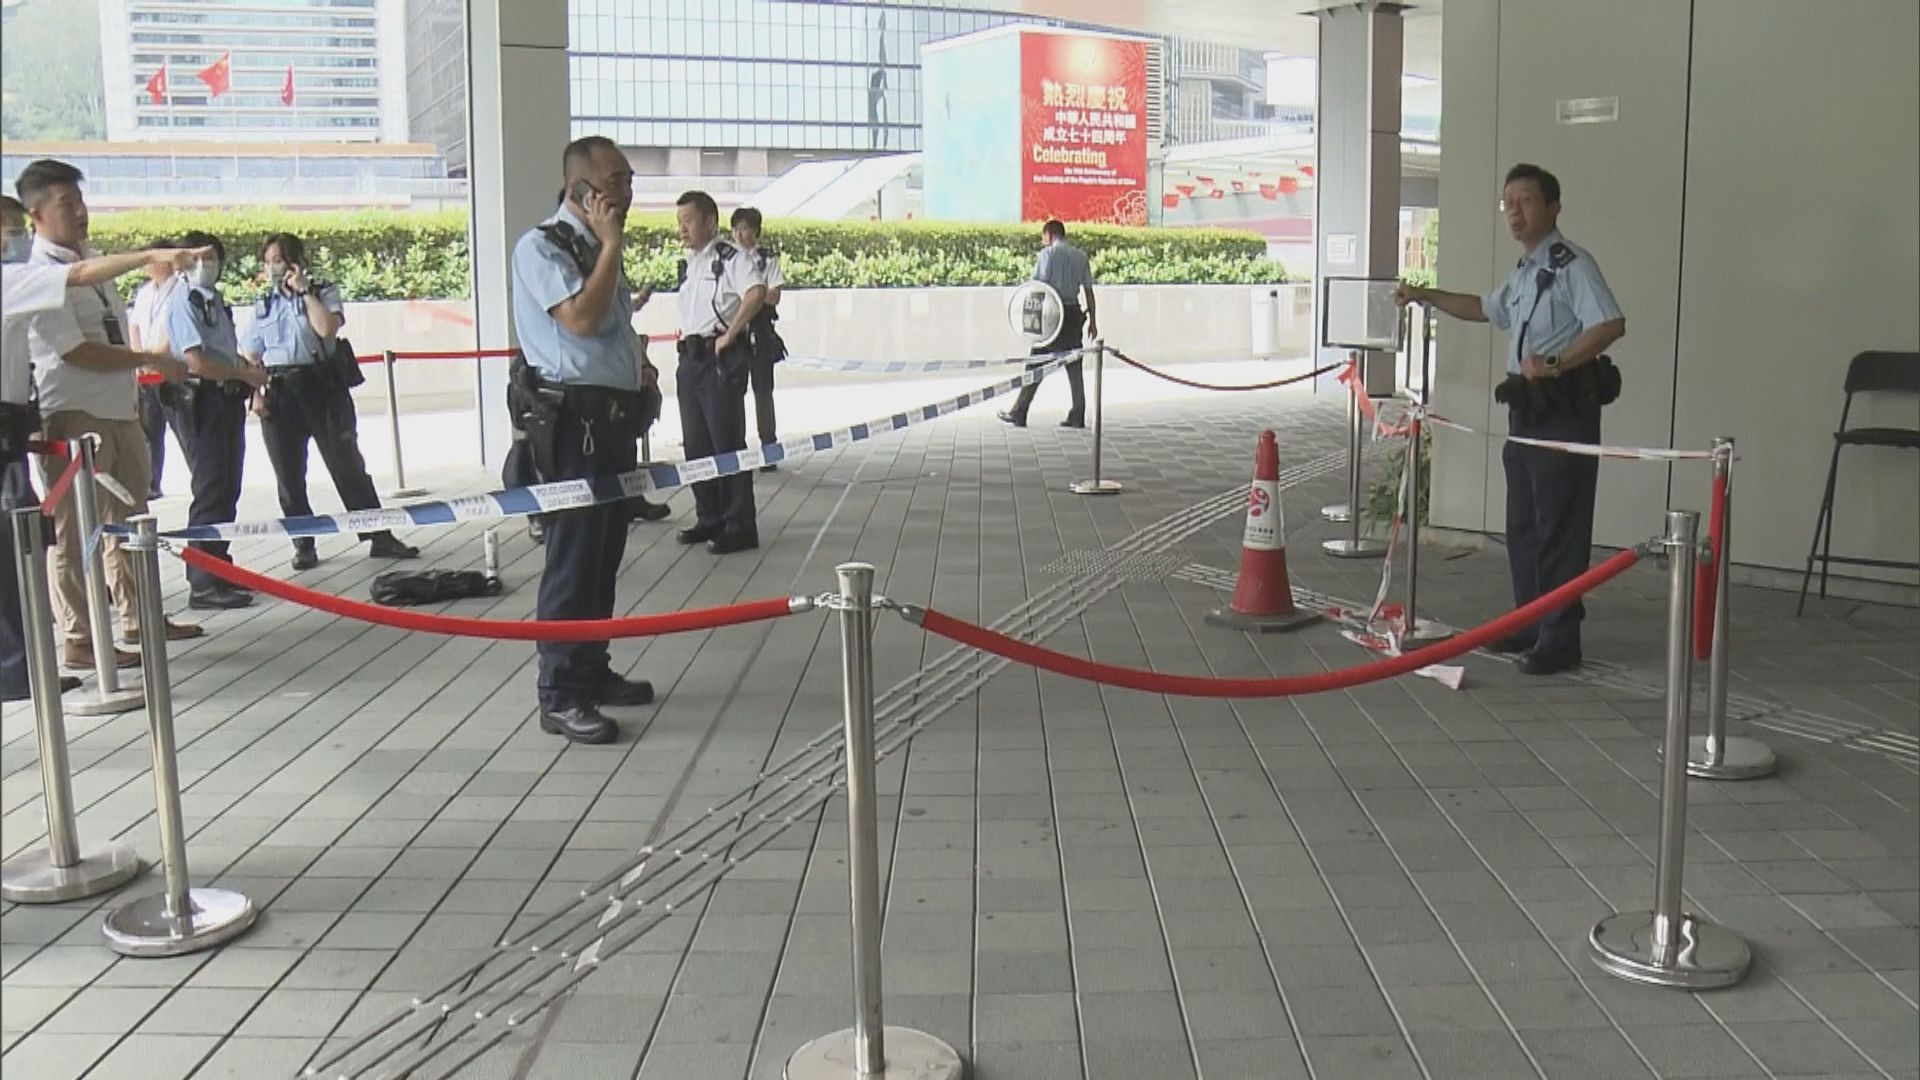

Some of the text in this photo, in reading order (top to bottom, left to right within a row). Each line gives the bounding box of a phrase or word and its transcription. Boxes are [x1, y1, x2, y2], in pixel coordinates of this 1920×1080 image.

[1055, 111, 1136, 129] 中華人民共和國
[1043, 126, 1126, 145] 成立七十四周年
[1033, 144, 1106, 168] Celebrating
[349, 518, 361, 529] DO
